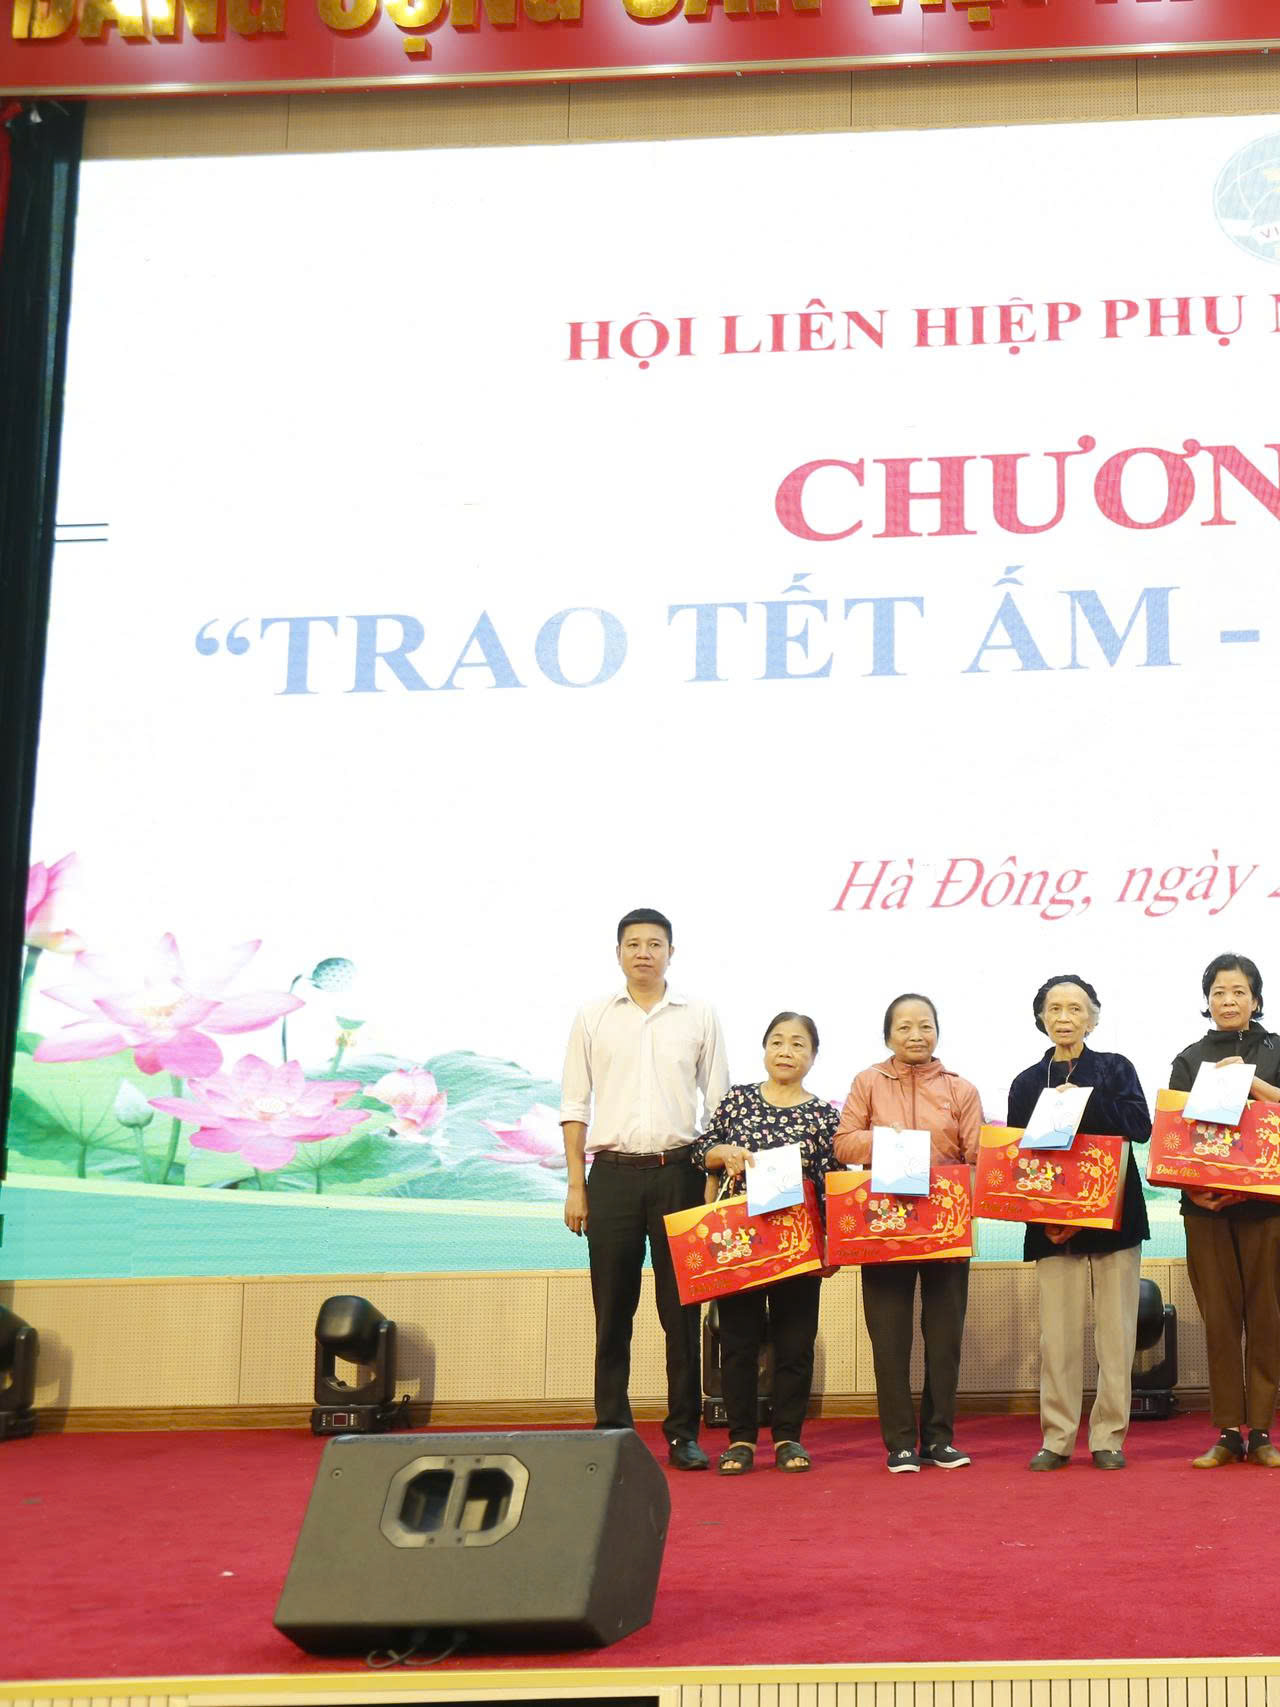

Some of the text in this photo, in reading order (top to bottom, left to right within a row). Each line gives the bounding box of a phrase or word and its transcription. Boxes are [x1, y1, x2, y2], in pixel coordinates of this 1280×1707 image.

[567, 311, 695, 370] HỘI
[719, 298, 887, 355] LIÊN
[914, 296, 1083, 356] HIỆP
[1103, 294, 1248, 347] PHỤ
[195, 606, 628, 695] “TRAO
[667, 573, 925, 683] TẾT
[961, 566, 1181, 673] ẤM
[829, 857, 916, 912] Hà
[930, 855, 1093, 920] Đông,
[1117, 847, 1258, 917] ngày
